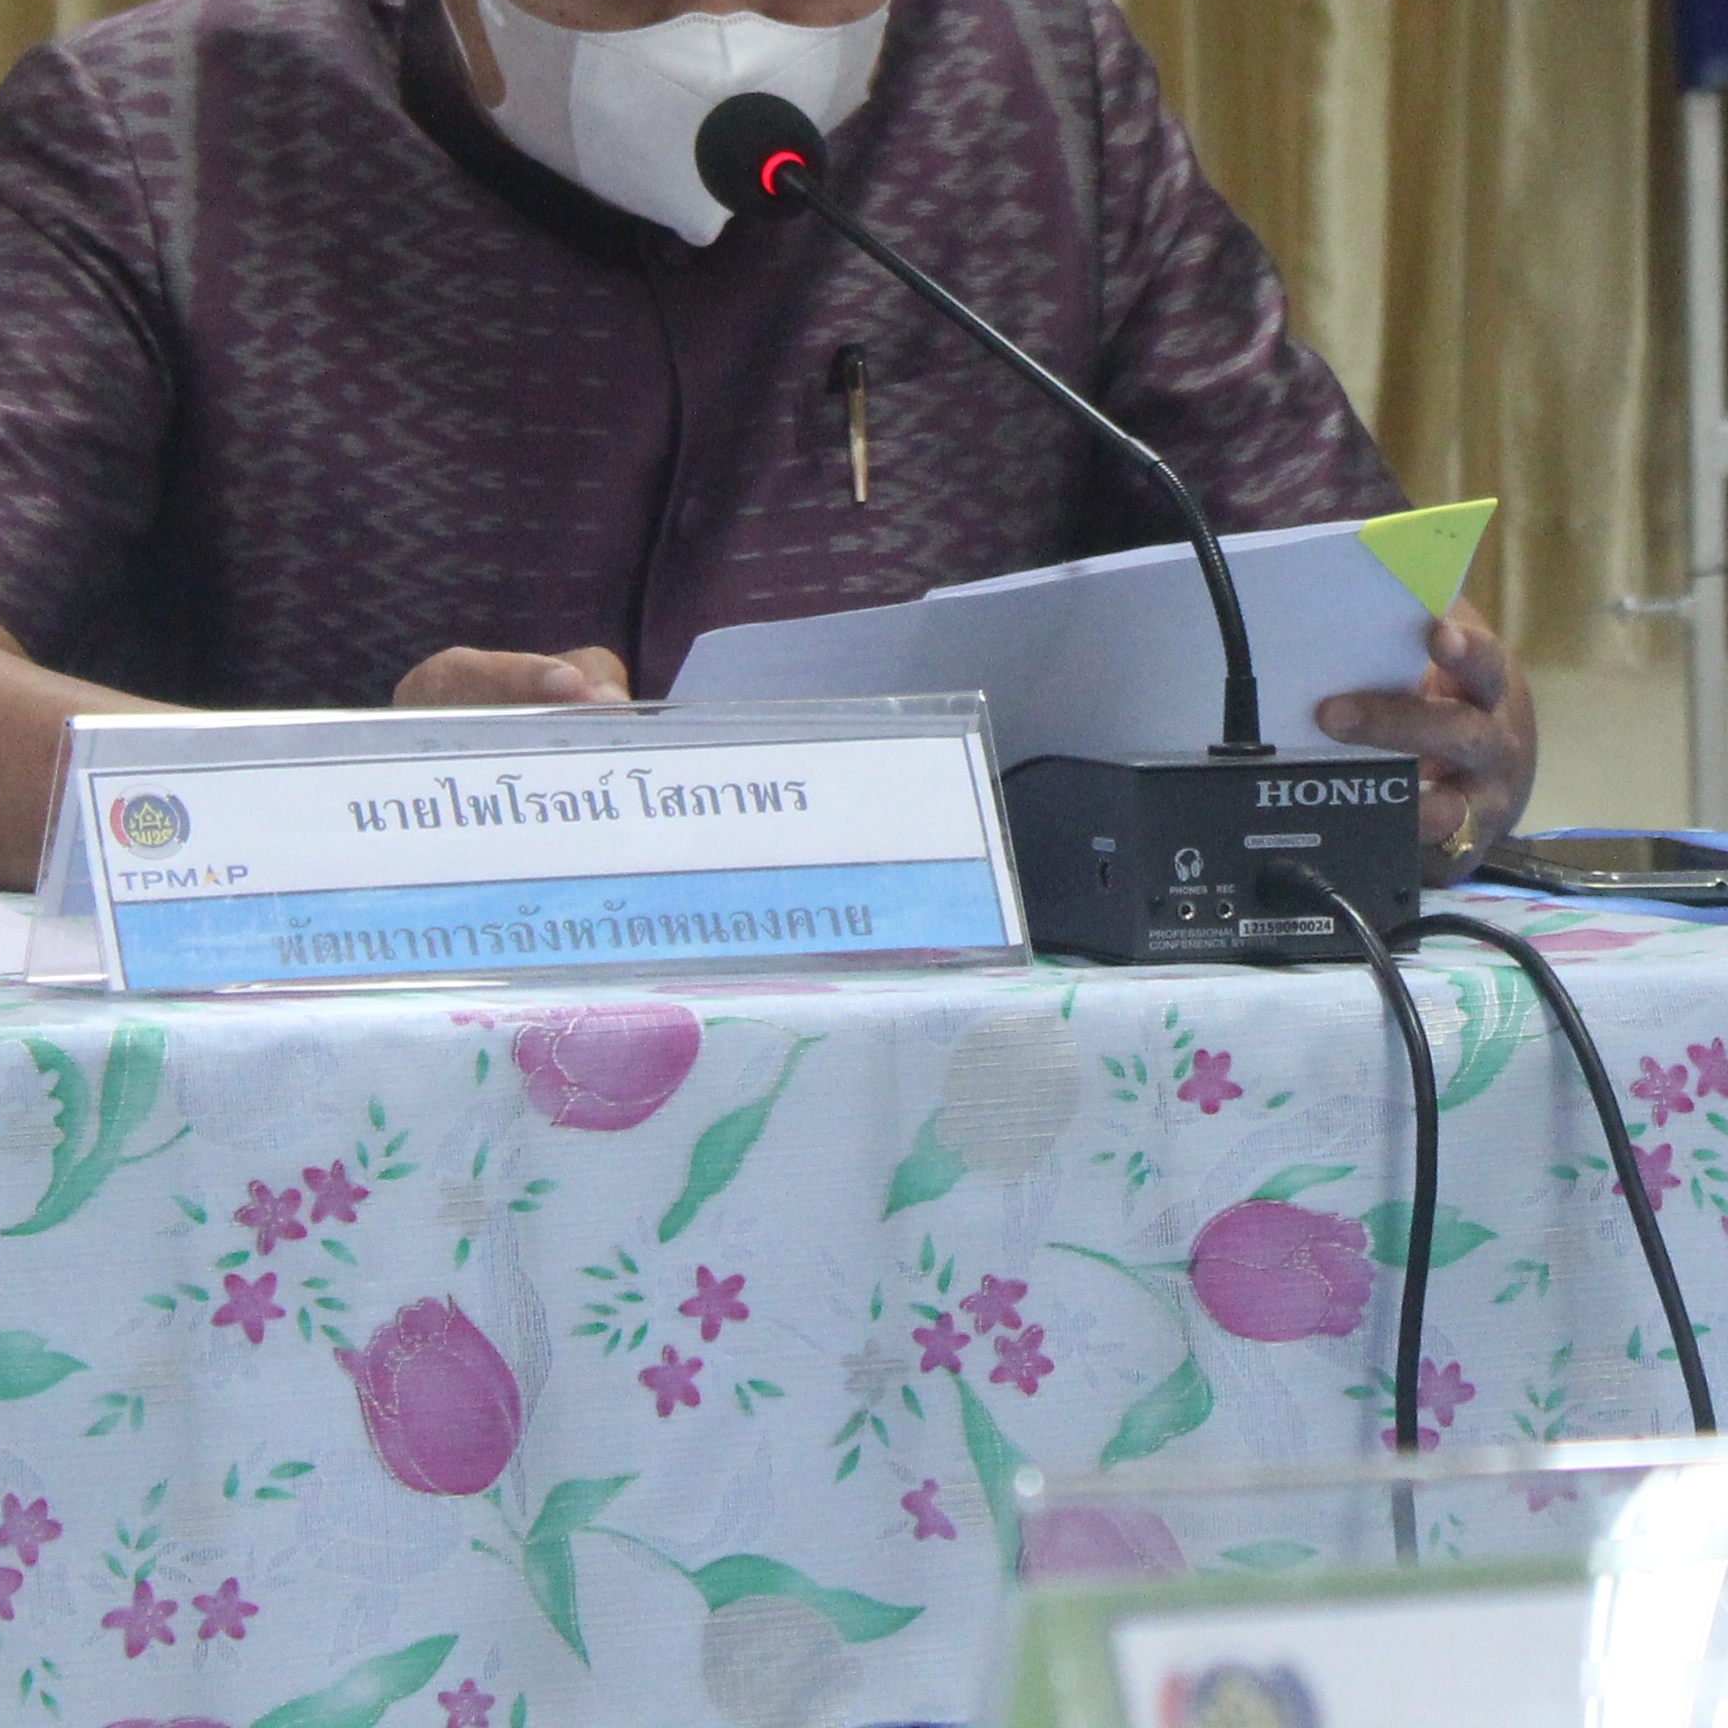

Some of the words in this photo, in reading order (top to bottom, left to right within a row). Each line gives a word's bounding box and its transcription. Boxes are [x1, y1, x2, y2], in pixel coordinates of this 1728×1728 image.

[348, 769, 621, 832] นายไพโรจน์
[626, 767, 809, 818] โสภาพร
[1255, 777, 1410, 807] HONiC
[272, 899, 874, 967] พัฒนาการจังหวัดหนองคาย
